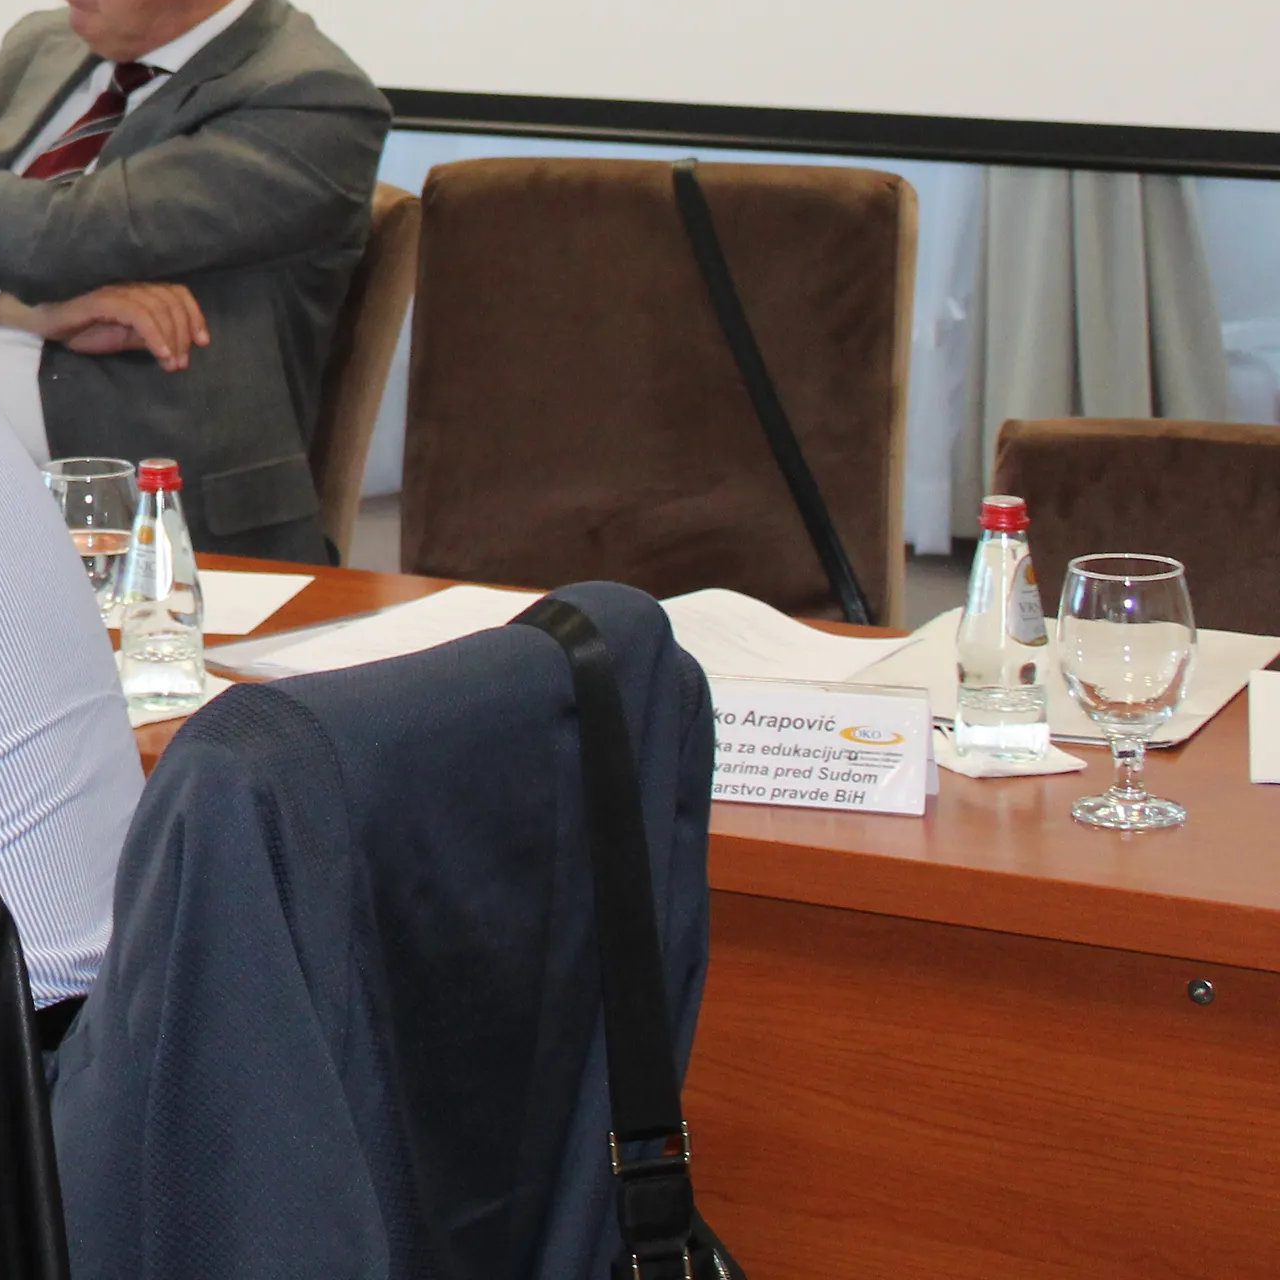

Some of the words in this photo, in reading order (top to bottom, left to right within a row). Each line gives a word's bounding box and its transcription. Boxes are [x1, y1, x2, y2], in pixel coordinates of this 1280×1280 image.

[741, 710, 836, 732] Arapović
[737, 743, 756, 754] za
[761, 743, 842, 763] edukaciju
[714, 761, 769, 776] varima
[774, 766, 813, 780] pred
[818, 767, 878, 784] Sudom
[713, 783, 766, 797] arstvo
[770, 787, 829, 802] pravde
[834, 789, 866, 805] BiH
